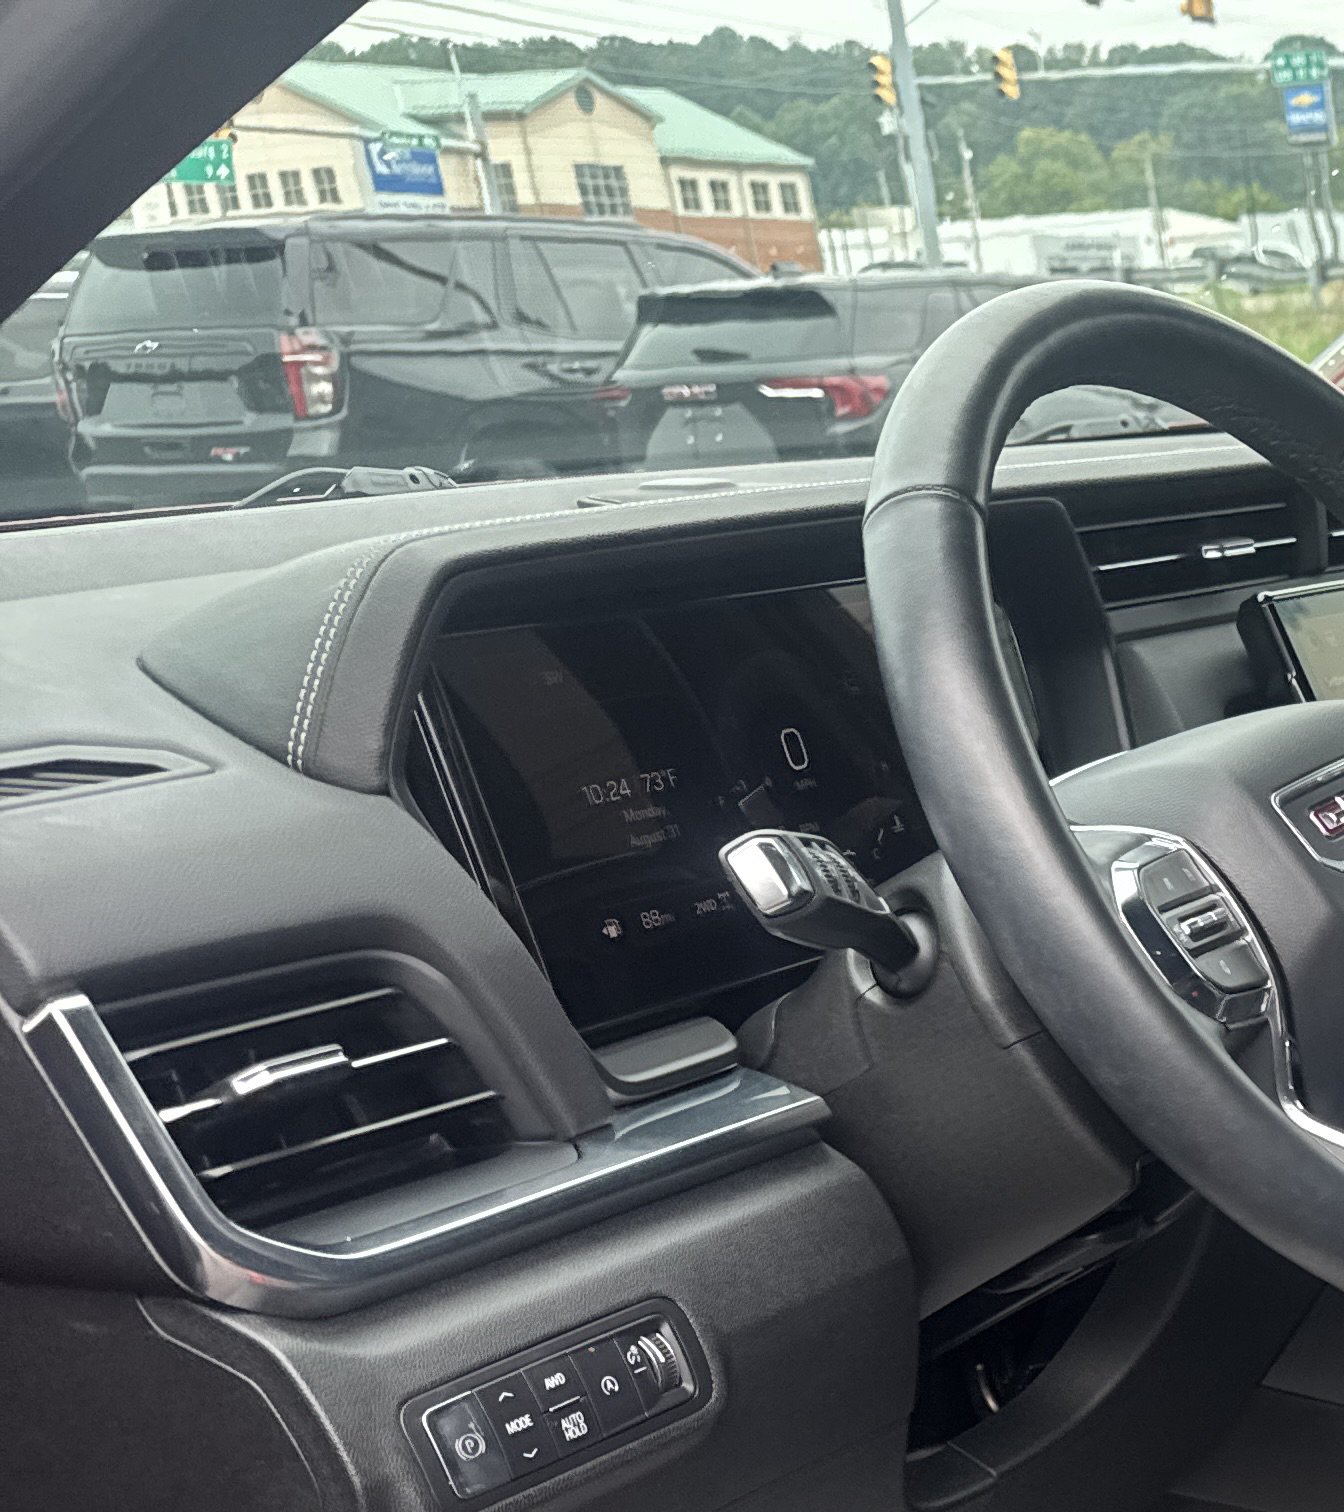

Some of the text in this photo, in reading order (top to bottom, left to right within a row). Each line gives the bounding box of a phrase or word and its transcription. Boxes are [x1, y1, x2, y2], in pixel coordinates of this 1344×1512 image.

[780, 727, 809, 770] 0
[581, 778, 632, 806] 10:24
[544, 1372, 566, 1391] AWD
[504, 1413, 535, 1435] MODE
[560, 1411, 585, 1431] AUTO
[564, 1423, 588, 1442] HOLD
